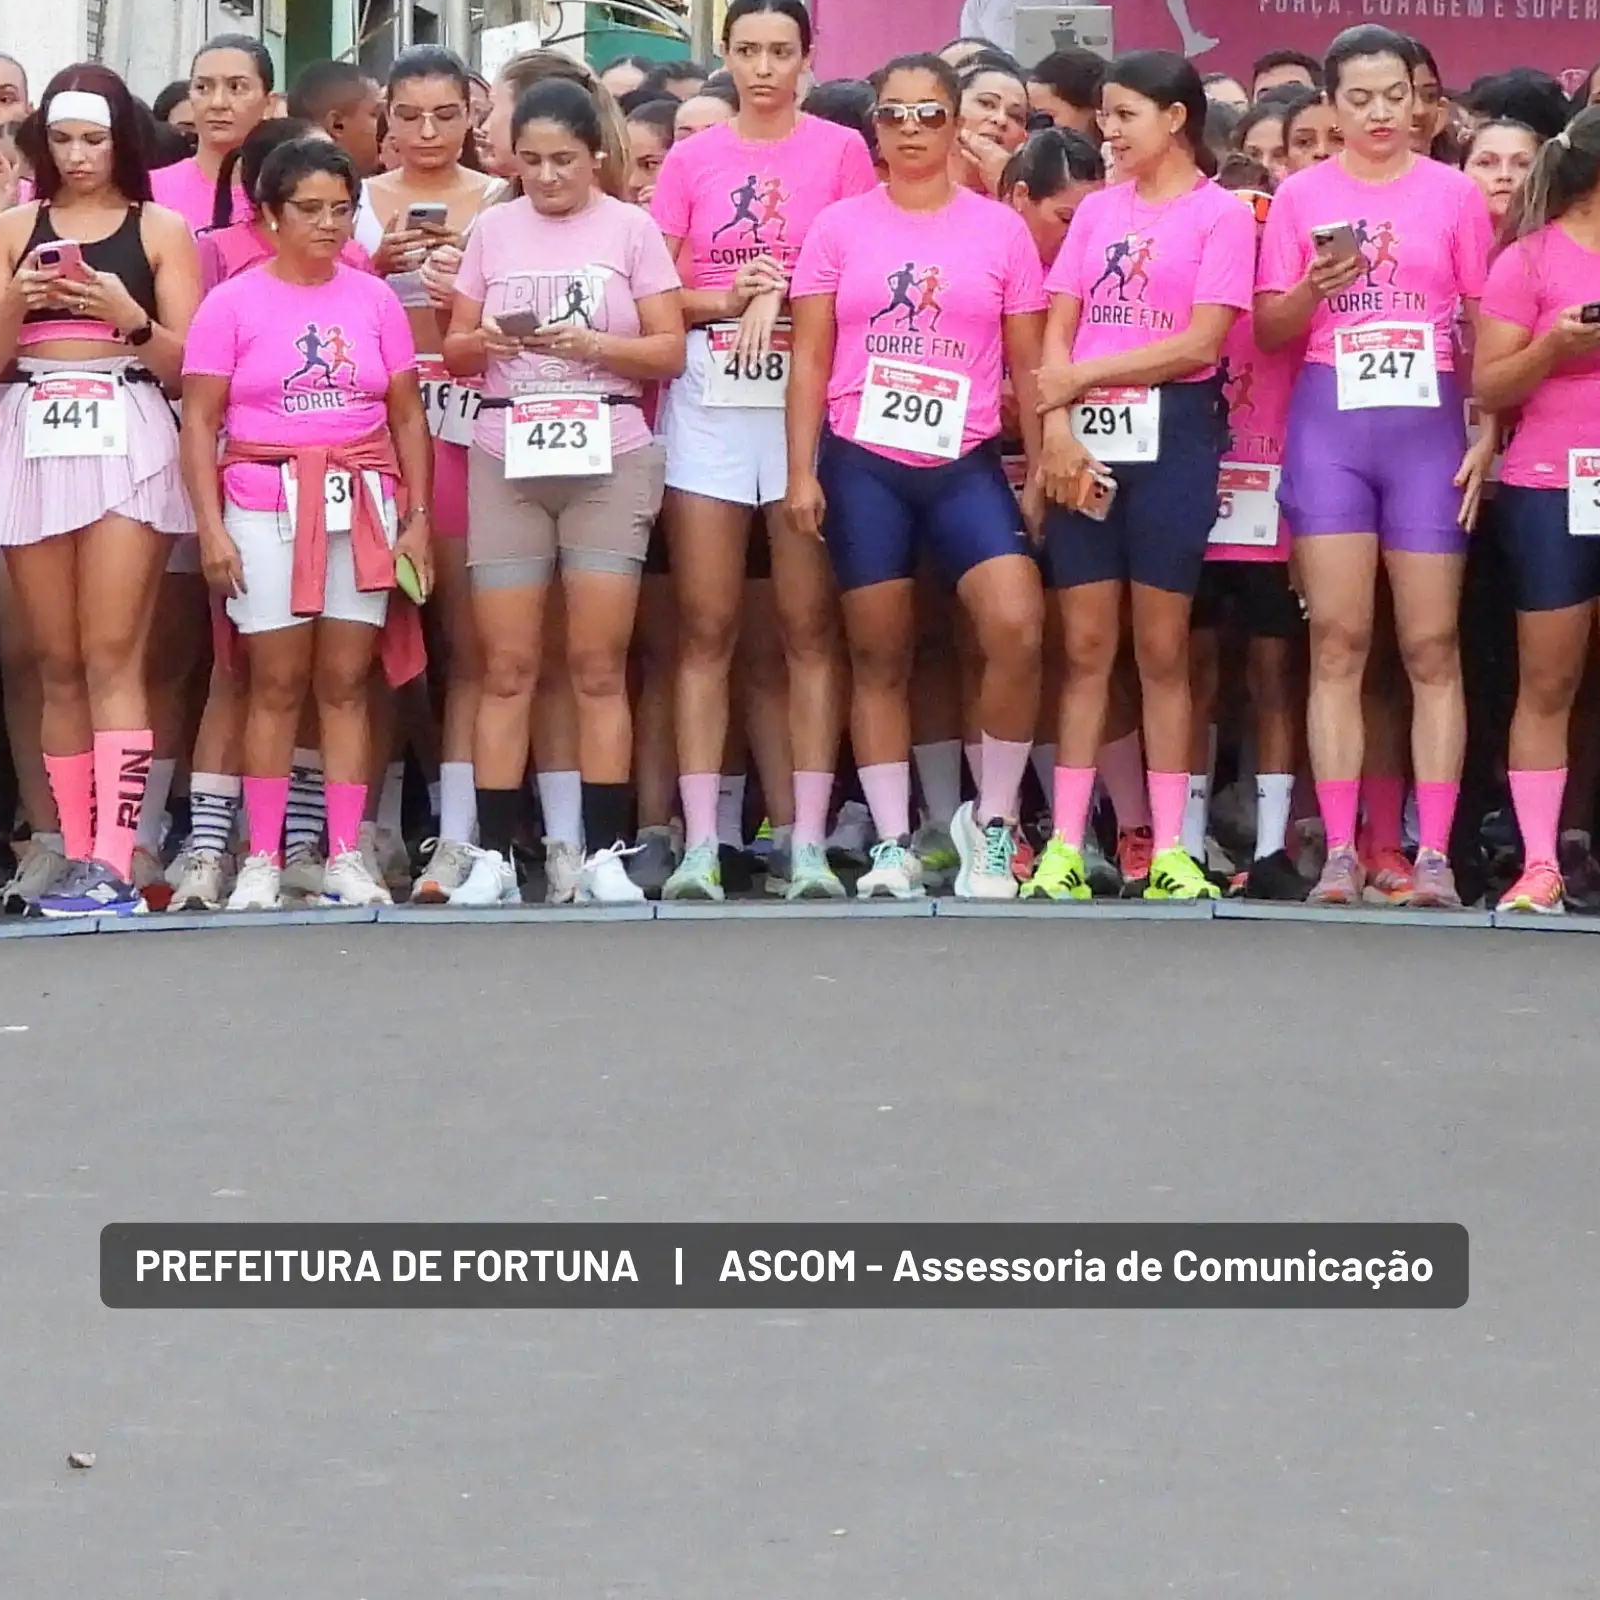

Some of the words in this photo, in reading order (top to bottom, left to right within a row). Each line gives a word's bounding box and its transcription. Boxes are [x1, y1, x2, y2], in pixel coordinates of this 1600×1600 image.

[1392, 291, 1427, 311] FTN
[1087, 305, 1133, 325] ORRE
[1139, 308, 1174, 330] FTN
[865, 334, 925, 355] CORRE
[931, 338, 967, 359] FTN
[1358, 351, 1416, 381] 247
[42, 400, 99, 430] 441
[283, 391, 345, 414] CORRE
[881, 390, 944, 428] 290
[1080, 405, 1133, 436] 291
[527, 421, 589, 450] 423
[116, 748, 154, 831] RUN
